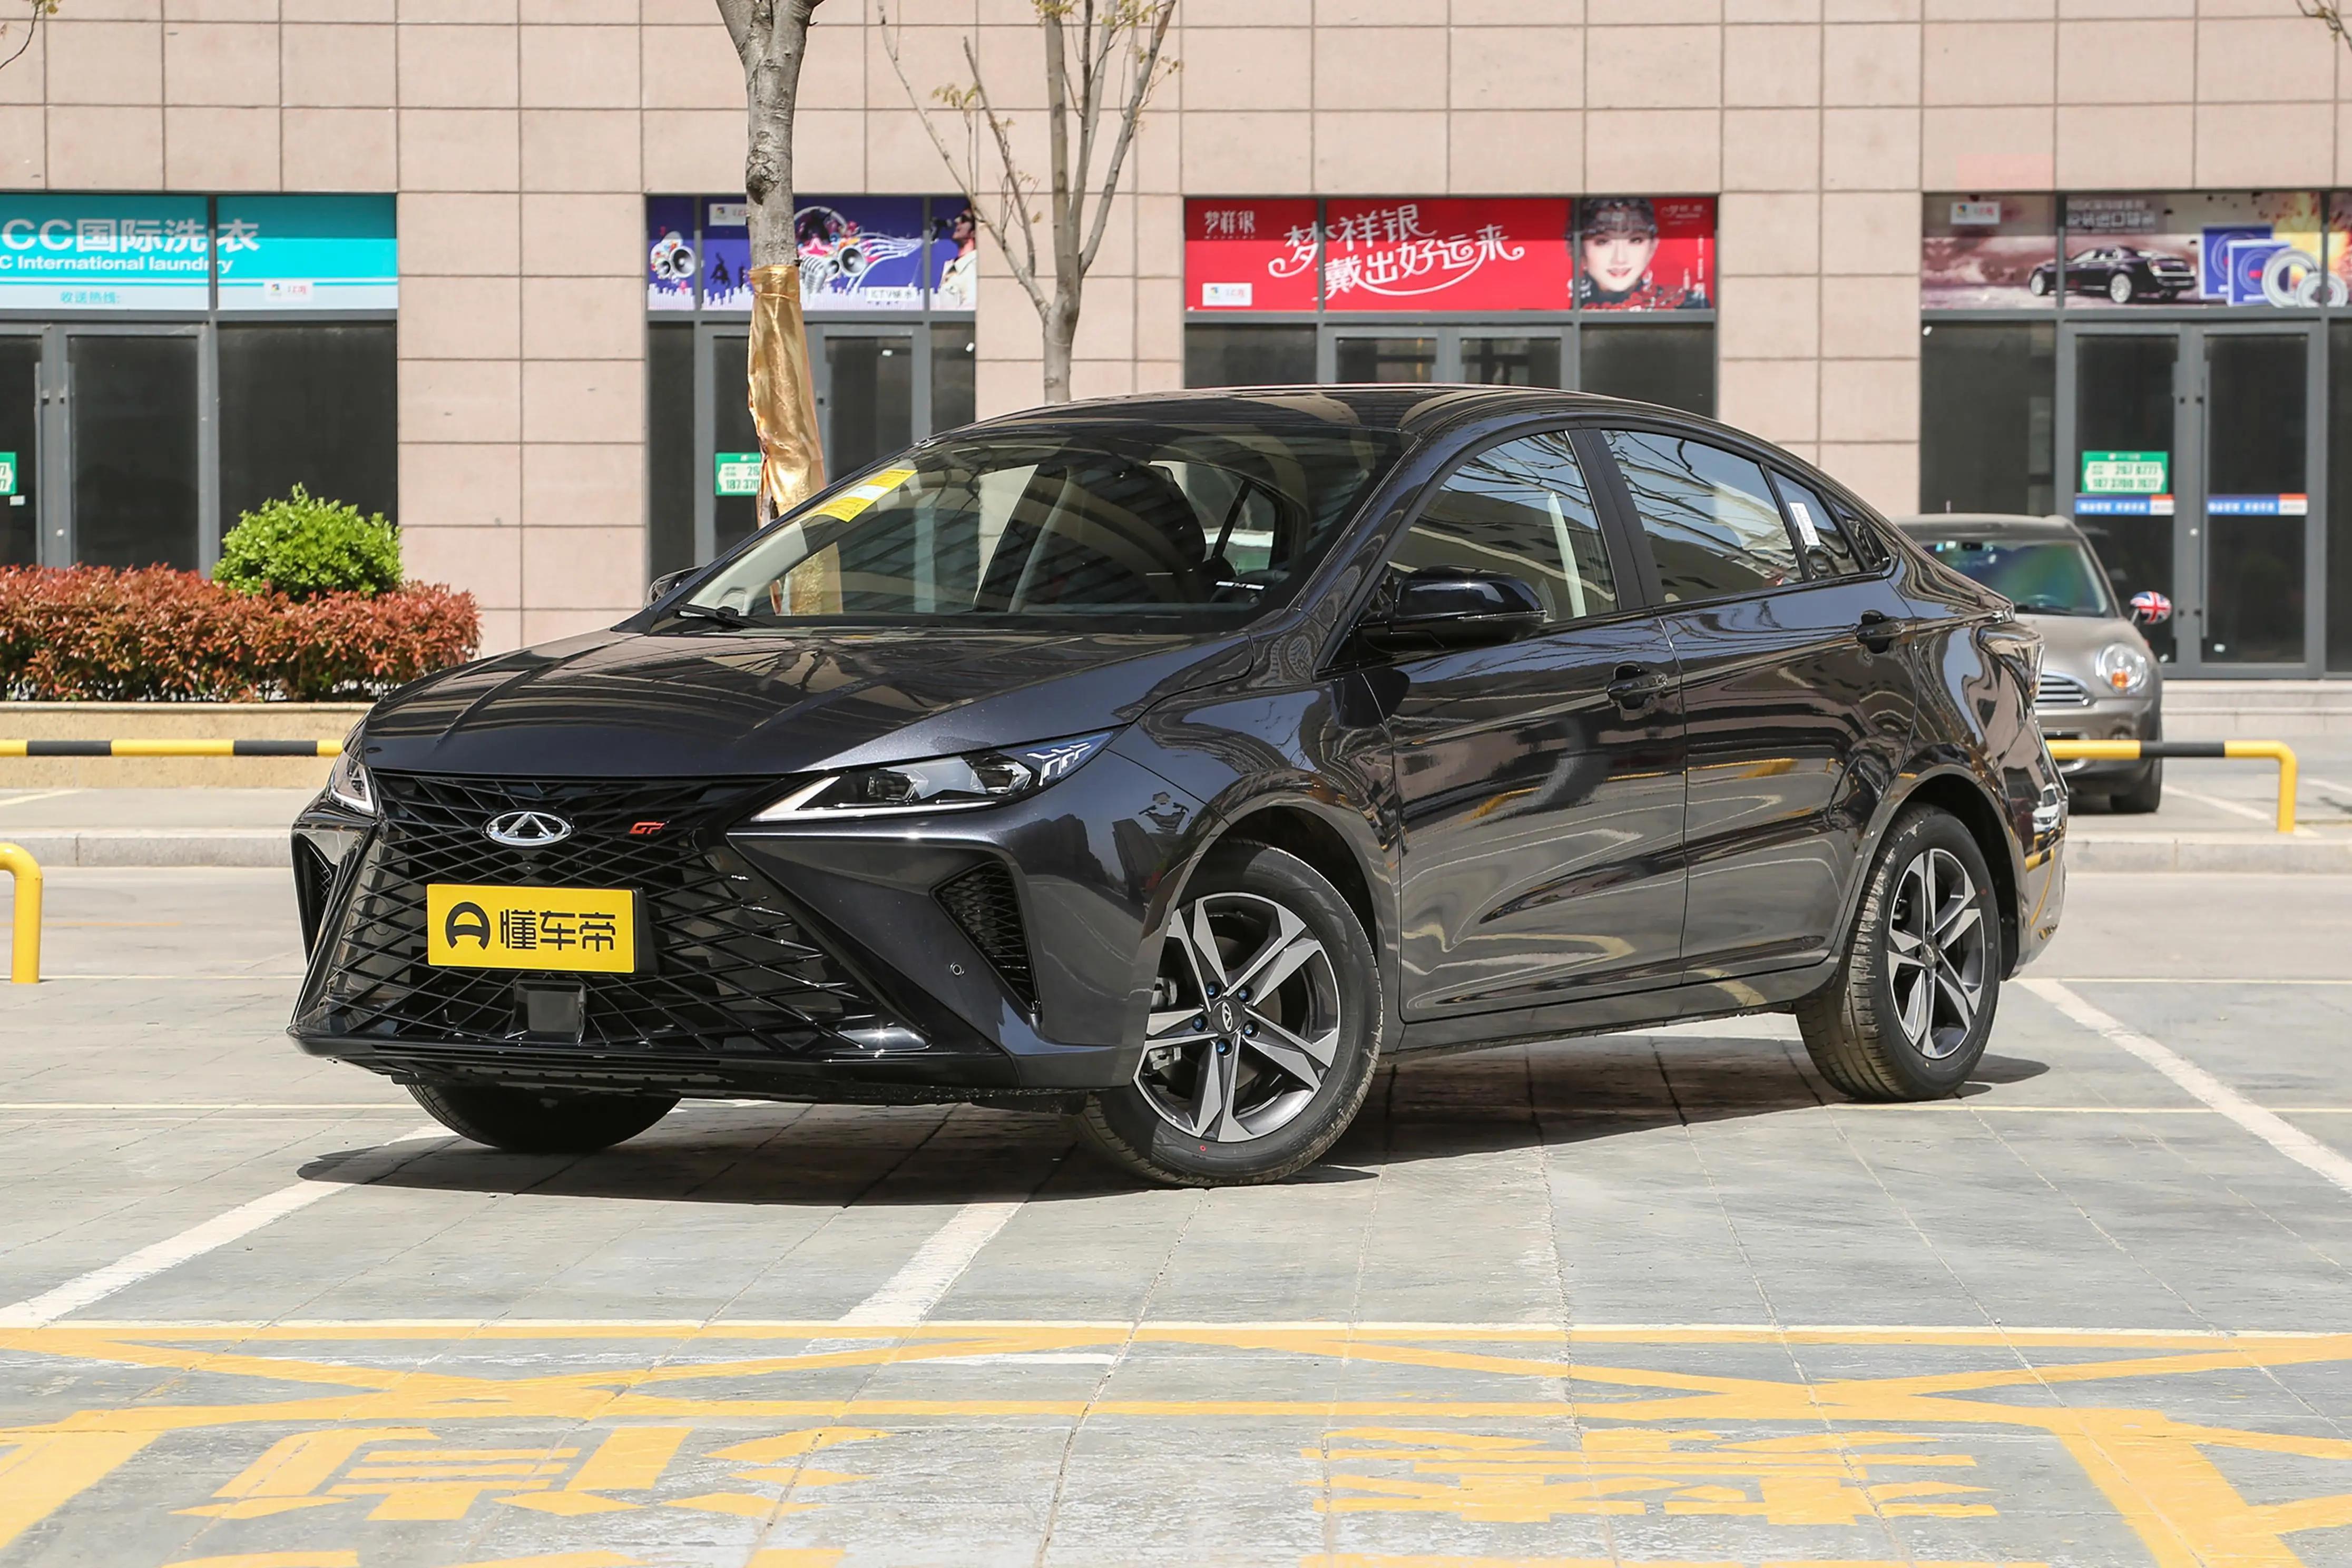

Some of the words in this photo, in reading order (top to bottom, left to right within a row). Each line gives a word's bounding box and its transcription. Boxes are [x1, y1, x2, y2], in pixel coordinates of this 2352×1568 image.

[2, 218, 260, 253] CC国际洗衣
[1268, 203, 1438, 278] 梦祥银
[18, 256, 144, 271] International
[1312, 224, 1525, 301] 戴出好运来
[629, 822, 665, 835] GT
[499, 908, 616, 953] 懂车帝
